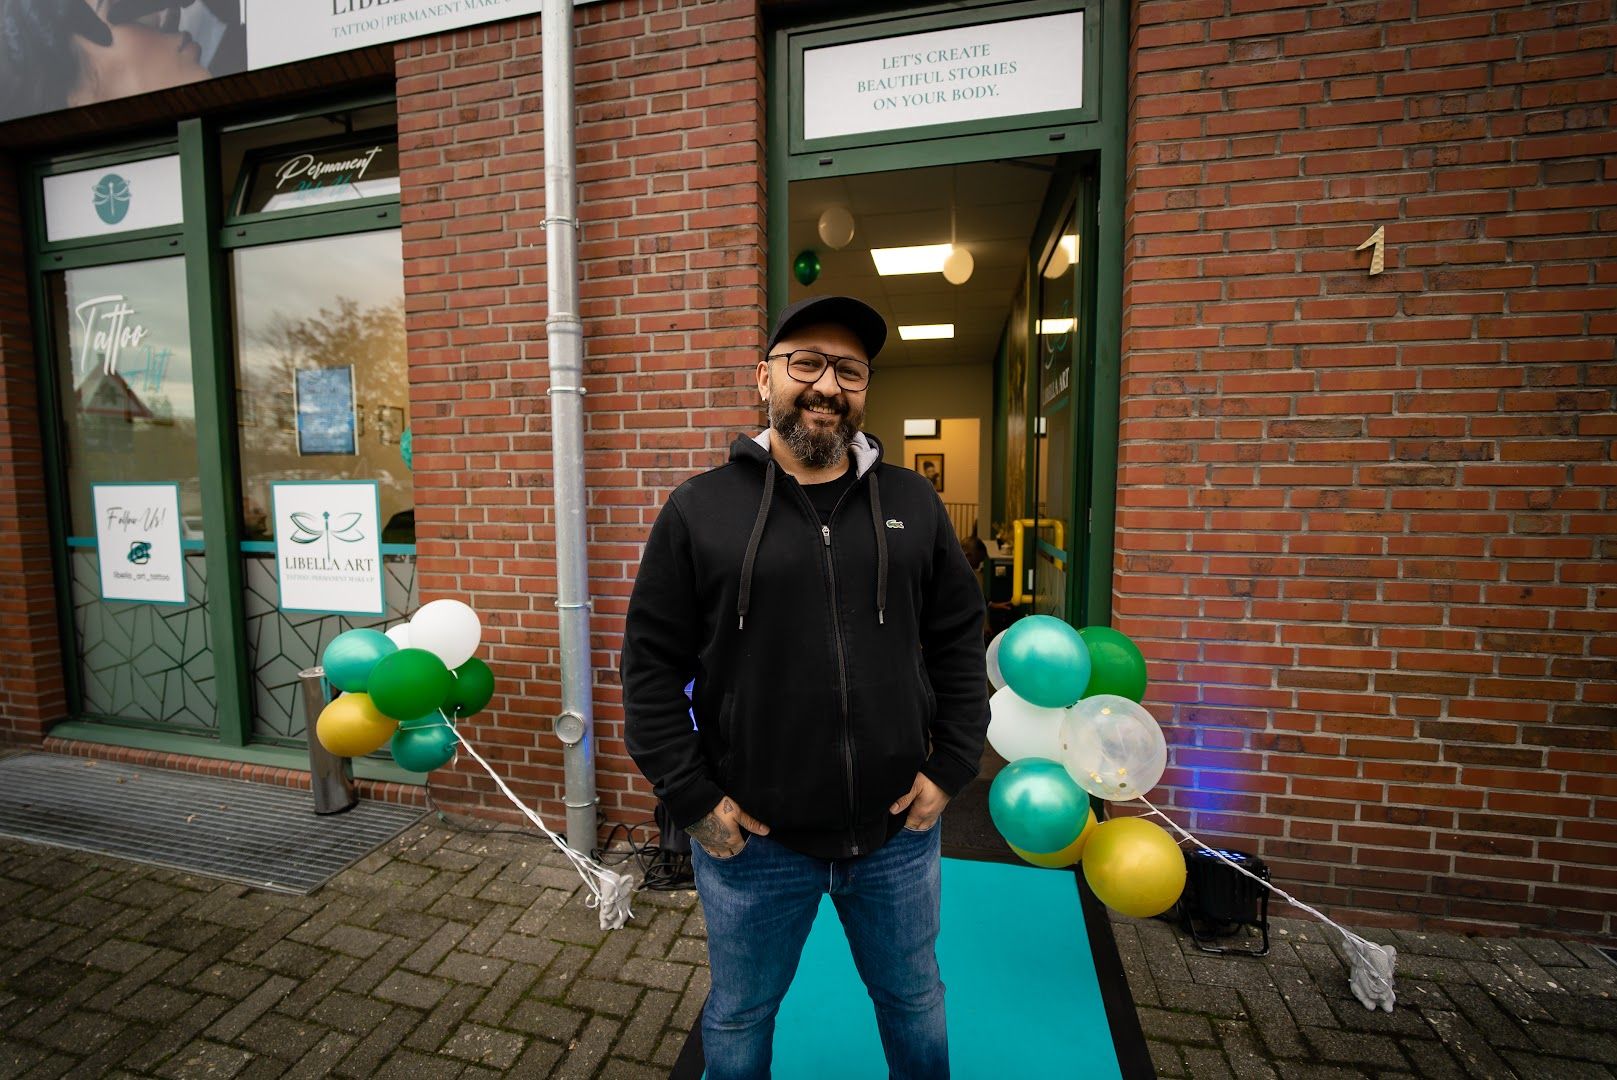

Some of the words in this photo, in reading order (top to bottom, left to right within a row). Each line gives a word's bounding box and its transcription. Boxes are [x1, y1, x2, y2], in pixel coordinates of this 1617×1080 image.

[332, 18, 379, 38] TATTOO
[386, 2, 461, 27] PERMANENT
[881, 53, 923, 70] LET'S
[926, 43, 991, 63] CREATE
[857, 71, 945, 93] BEAUTIFUL
[948, 61, 1018, 81] STORIES
[873, 96, 898, 112] ON
[902, 90, 947, 107] YOUR
[952, 84, 1000, 101] BODY.
[275, 146, 382, 190] Permanent
[1356, 225, 1385, 276] 1
[75, 294, 148, 376] Tattoo
[106, 507, 138, 532] Follow
[285, 557, 340, 571] LIBELLA
[344, 558, 373, 572] ART
